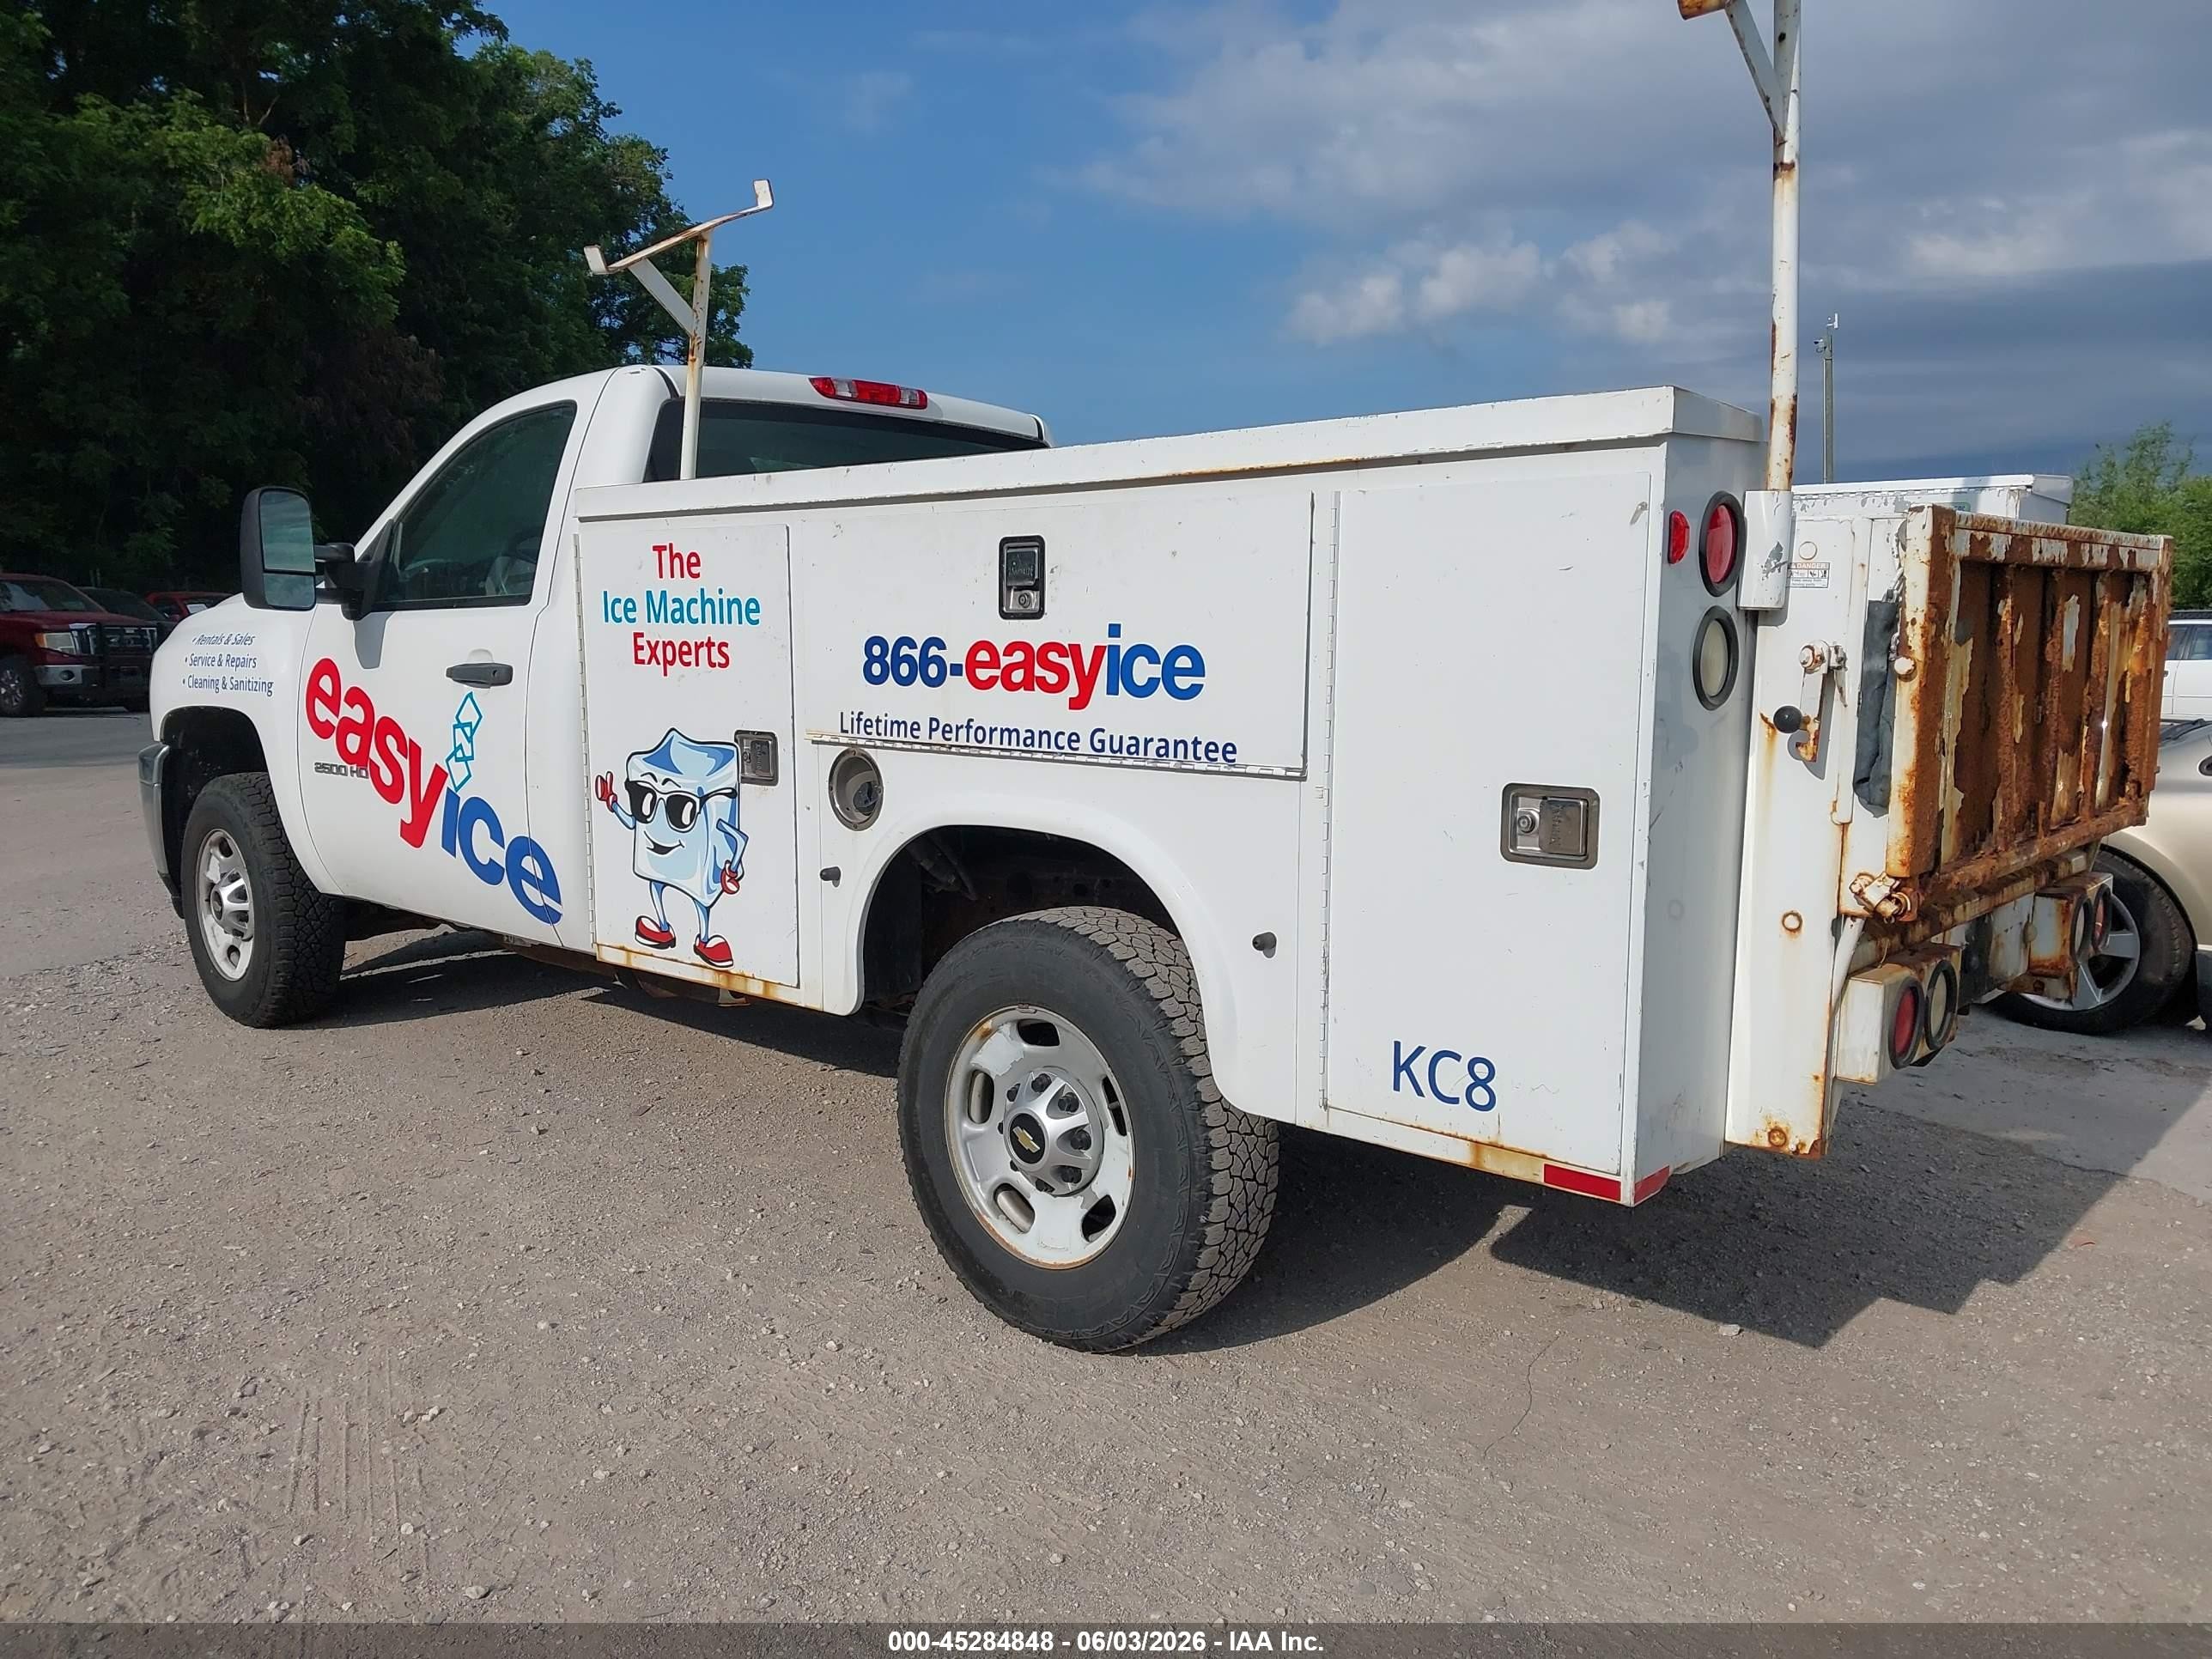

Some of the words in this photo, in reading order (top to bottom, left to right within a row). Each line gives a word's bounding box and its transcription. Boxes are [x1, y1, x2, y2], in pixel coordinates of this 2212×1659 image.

[652, 542, 702, 580] The
[603, 590, 637, 623] Ice
[646, 587, 761, 626] Machine
[194, 633, 223, 646] Rentals
[223, 634, 233, 646] &
[231, 633, 256, 646] Sales
[632, 631, 731, 677] Experts
[189, 653, 216, 667] Service
[216, 653, 223, 667] &
[225, 653, 257, 672] Repairs
[187, 674, 220, 694] Cleaning
[221, 676, 228, 690] &
[229, 676, 274, 697] Sanitizing
[839, 710, 921, 739] Lifetime
[928, 716, 1081, 751] Performance
[1089, 727, 1237, 763] Guarantee
[314, 762, 348, 777] 2500
[349, 765, 369, 779] HD
[1393, 1040, 1497, 1112] KC8
